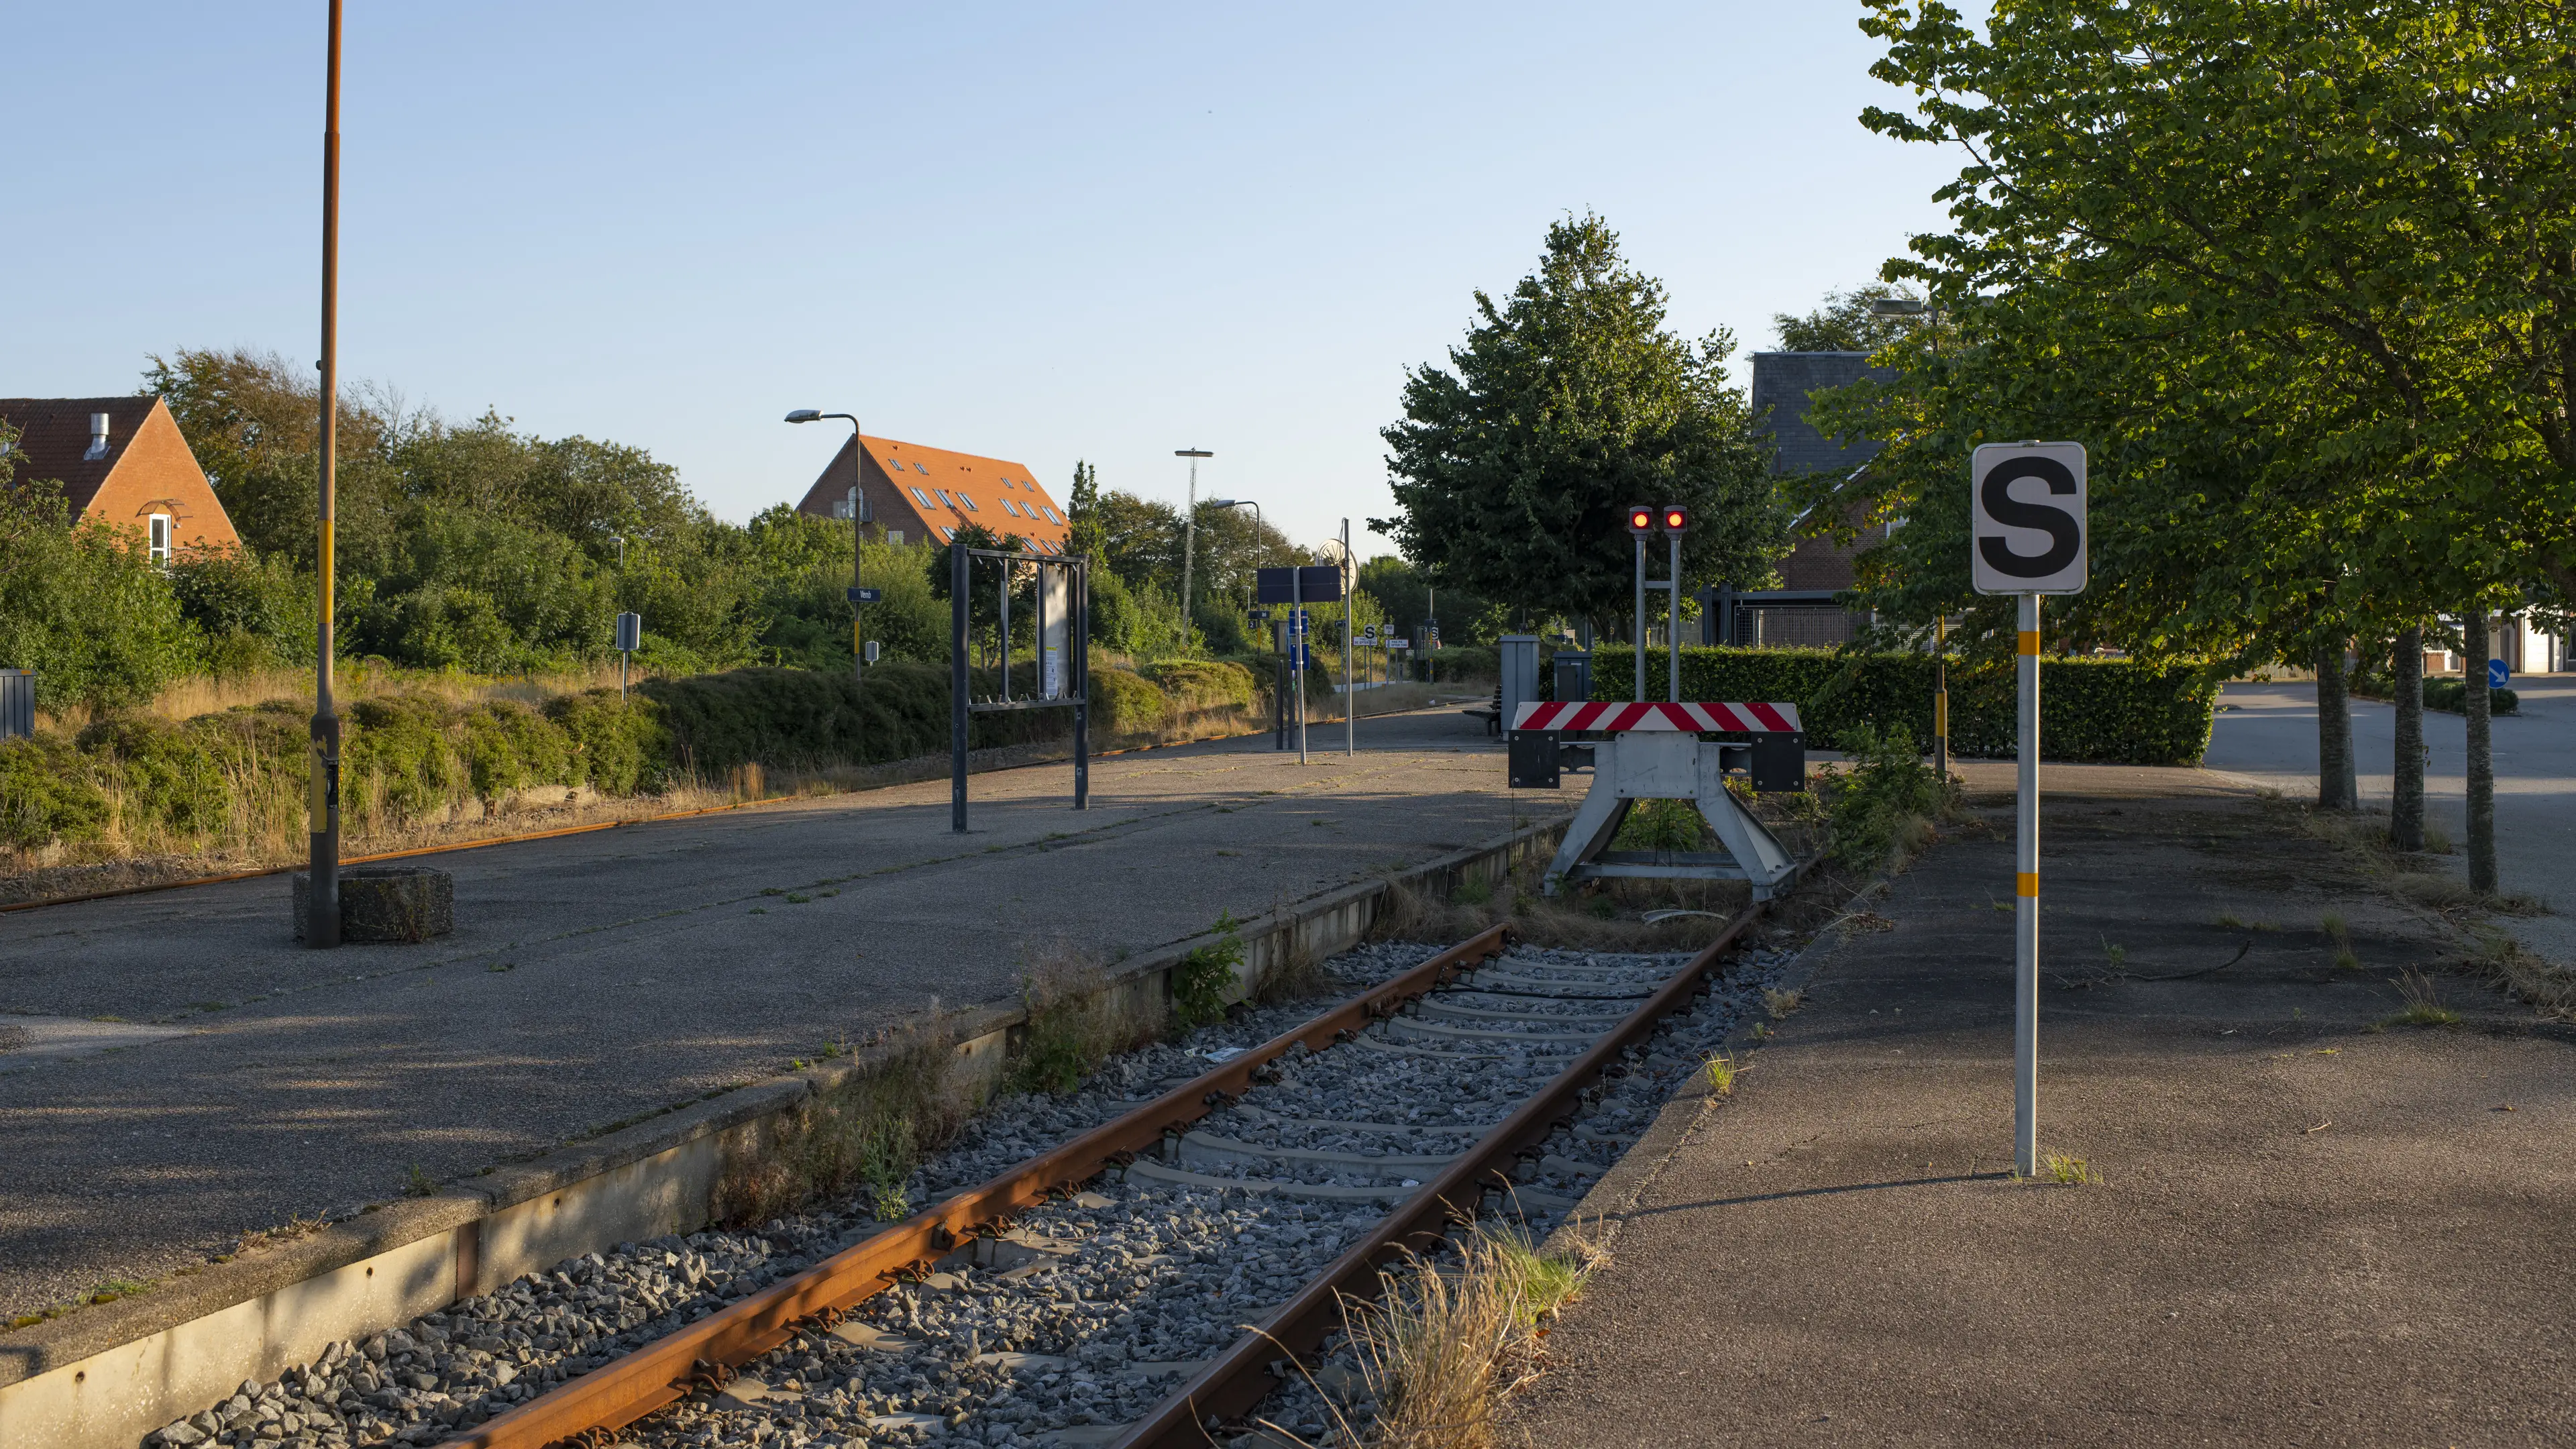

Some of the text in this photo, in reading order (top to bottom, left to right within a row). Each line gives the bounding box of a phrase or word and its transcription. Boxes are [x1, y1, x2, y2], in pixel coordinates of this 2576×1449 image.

[1978, 456, 2080, 578] S
[860, 590, 871, 598] Vemb
[1365, 627, 1375, 639] S
[1432, 629, 1438, 637] S
